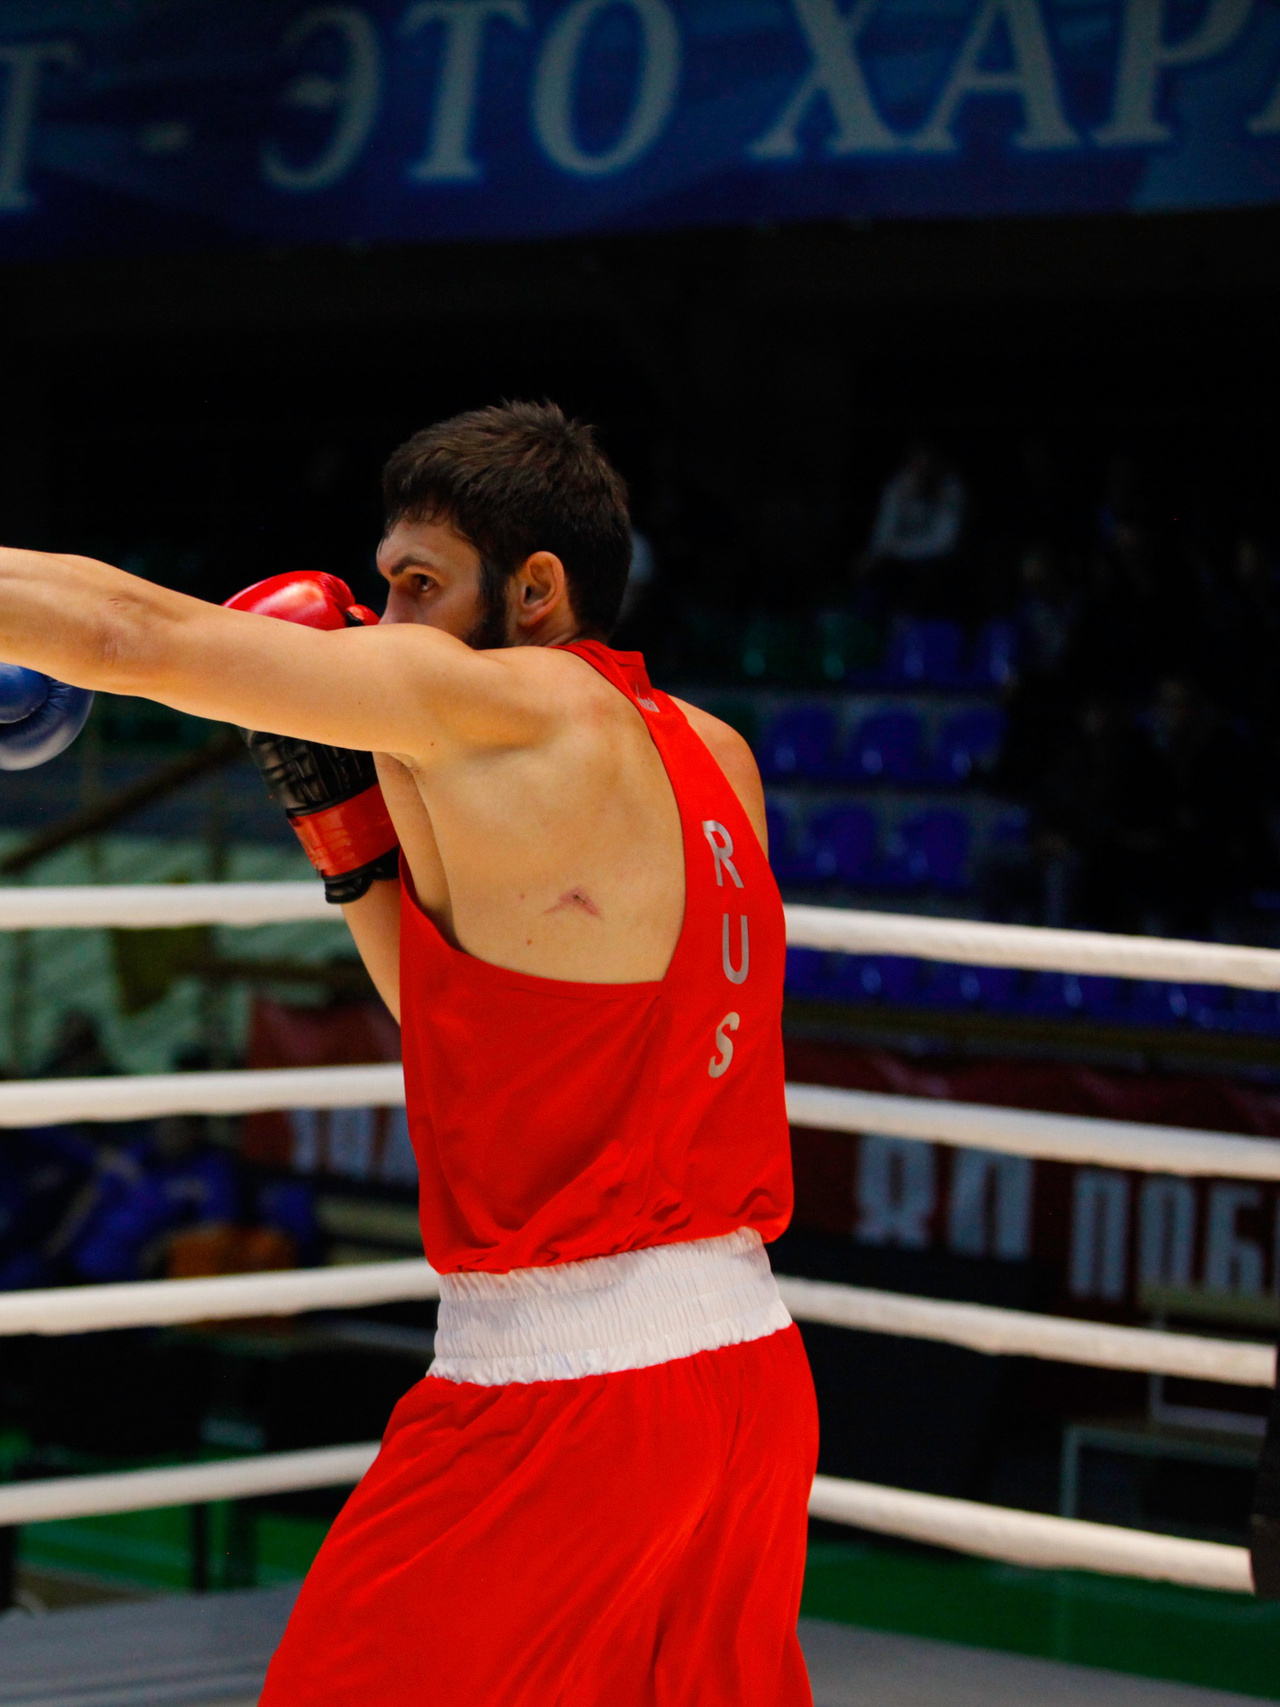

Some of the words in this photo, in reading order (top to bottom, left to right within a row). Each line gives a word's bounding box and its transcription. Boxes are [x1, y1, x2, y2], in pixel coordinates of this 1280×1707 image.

[259, 0, 683, 189] ЭТО
[744, 0, 1280, 160] ХАР
[1068, 1164, 1280, 1298] ПОБ
